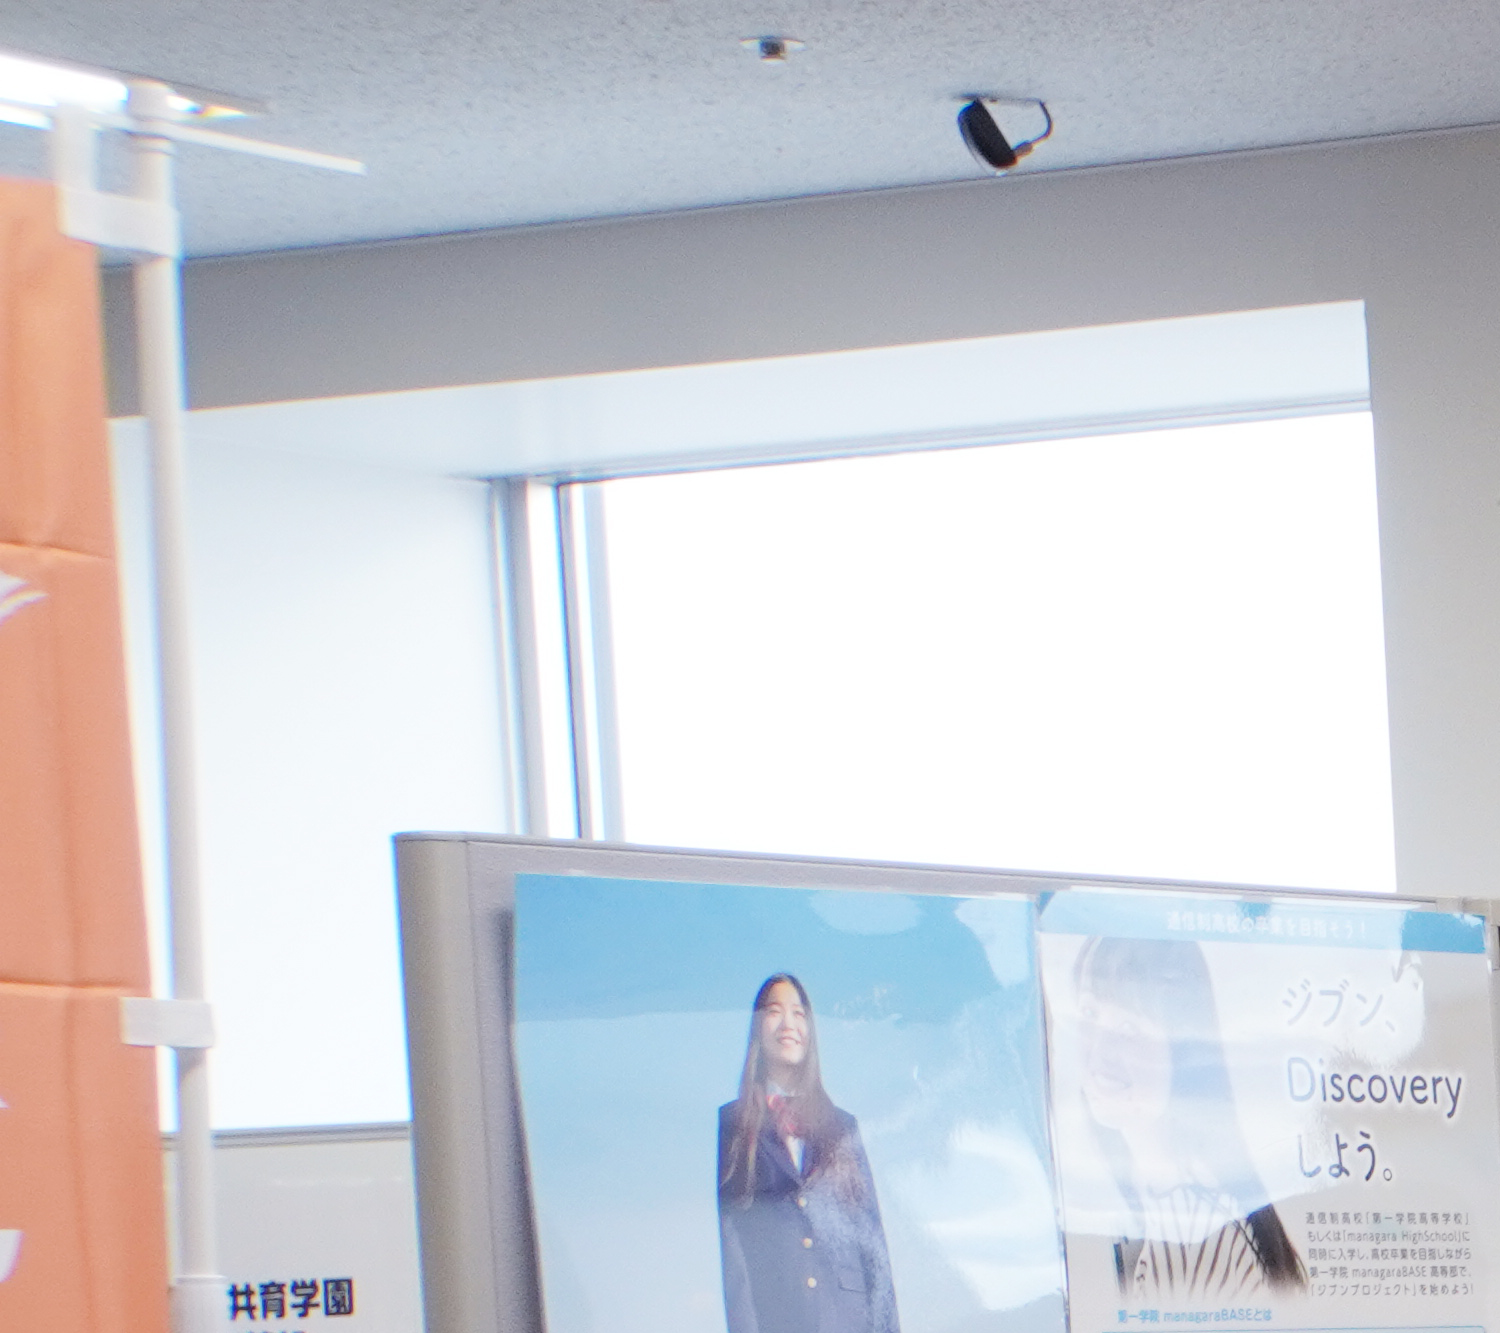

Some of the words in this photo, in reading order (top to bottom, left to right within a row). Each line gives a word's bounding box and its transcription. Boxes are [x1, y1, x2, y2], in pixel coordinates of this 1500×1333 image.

[1282, 978, 1395, 1032] ジブン、
[1287, 1056, 1463, 1118] Discovery
[1298, 1130, 1394, 1182] しよう。
